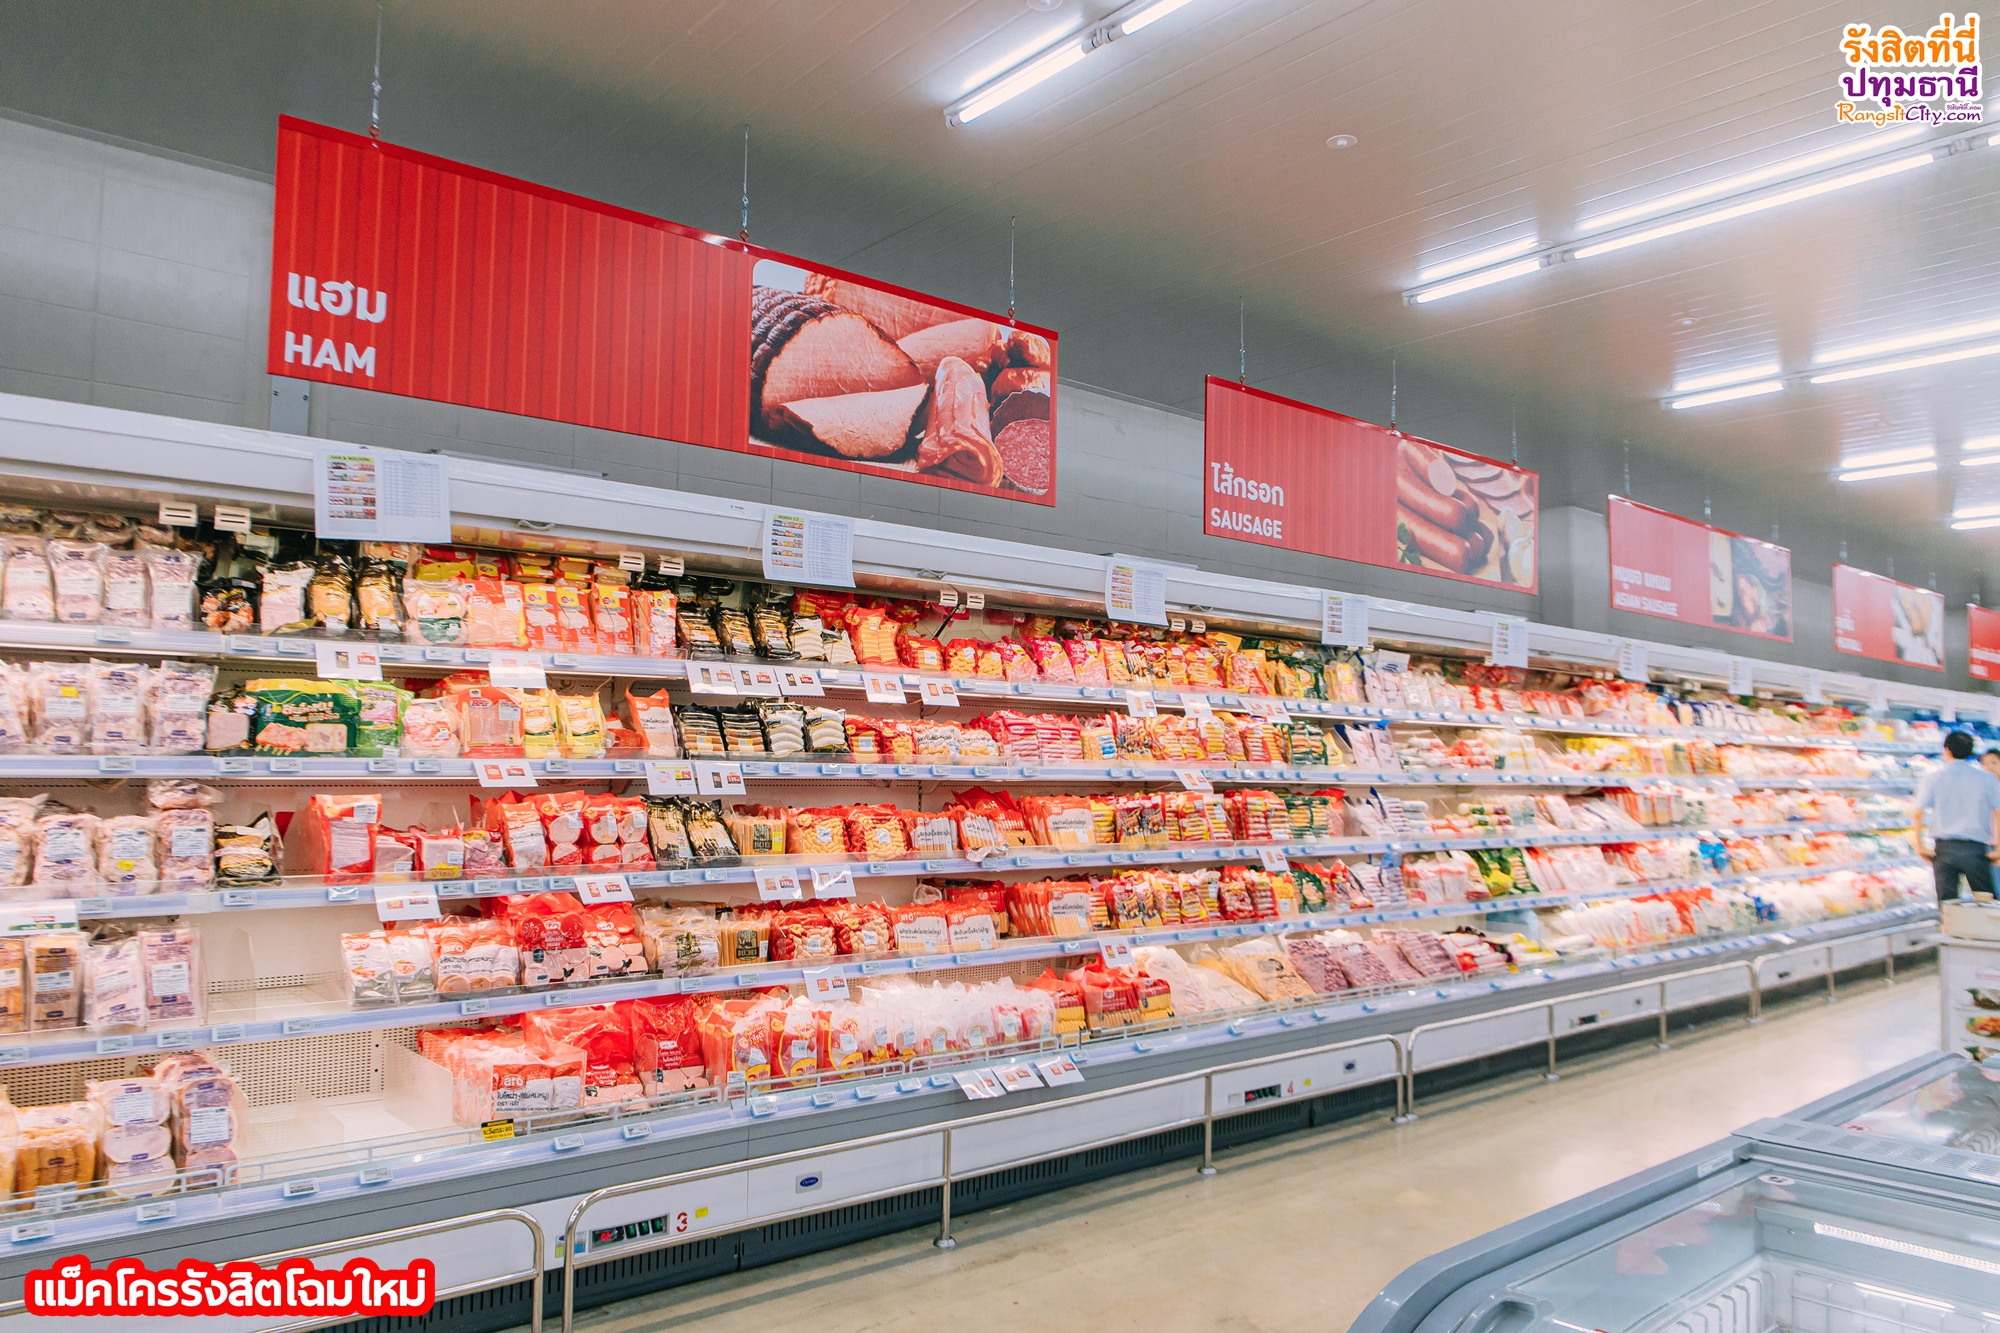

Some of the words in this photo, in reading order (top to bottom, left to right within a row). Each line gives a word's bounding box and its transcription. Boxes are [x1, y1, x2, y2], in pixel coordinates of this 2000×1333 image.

[287, 272, 388, 323] แฮม
[284, 331, 376, 377] HAM
[1211, 462, 1285, 507] ไส้กรอก
[1210, 507, 1283, 540] SAUSAGE
[503, 1077, 523, 1087] aro
[676, 1211, 689, 1233] 3
